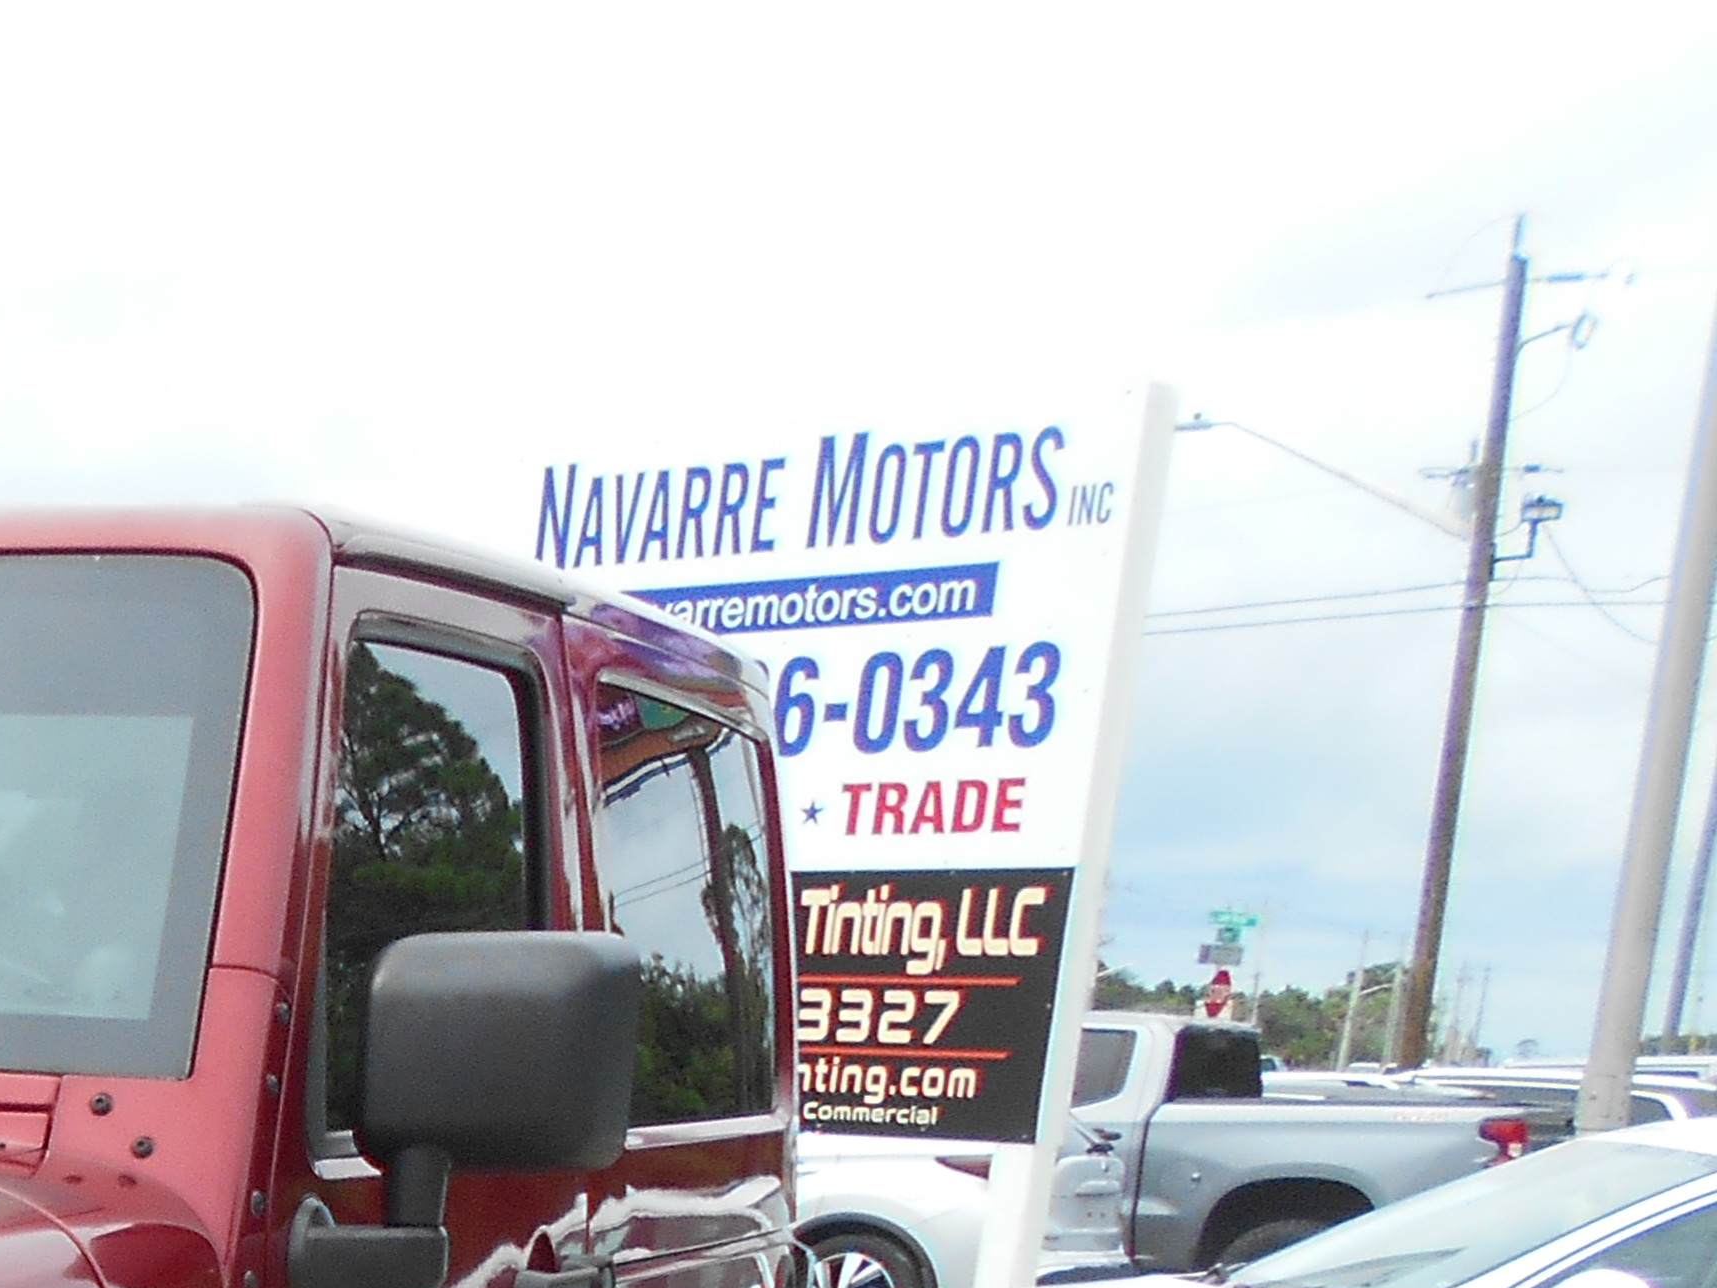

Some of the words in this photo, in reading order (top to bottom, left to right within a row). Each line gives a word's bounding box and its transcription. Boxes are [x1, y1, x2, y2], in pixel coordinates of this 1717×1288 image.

[535, 456, 786, 569] NAVARRE
[806, 426, 1065, 549] MOTORS
[1067, 482, 1114, 526] INC
[658, 577, 976, 629] arremotors.com
[754, 641, 1062, 757] 6-0343
[842, 777, 1027, 836] TRADE
[801, 883, 948, 975] Tinting,
[956, 886, 1048, 956] LLC
[796, 988, 961, 1045] 3327
[803, 1101, 938, 1125] Commercial
